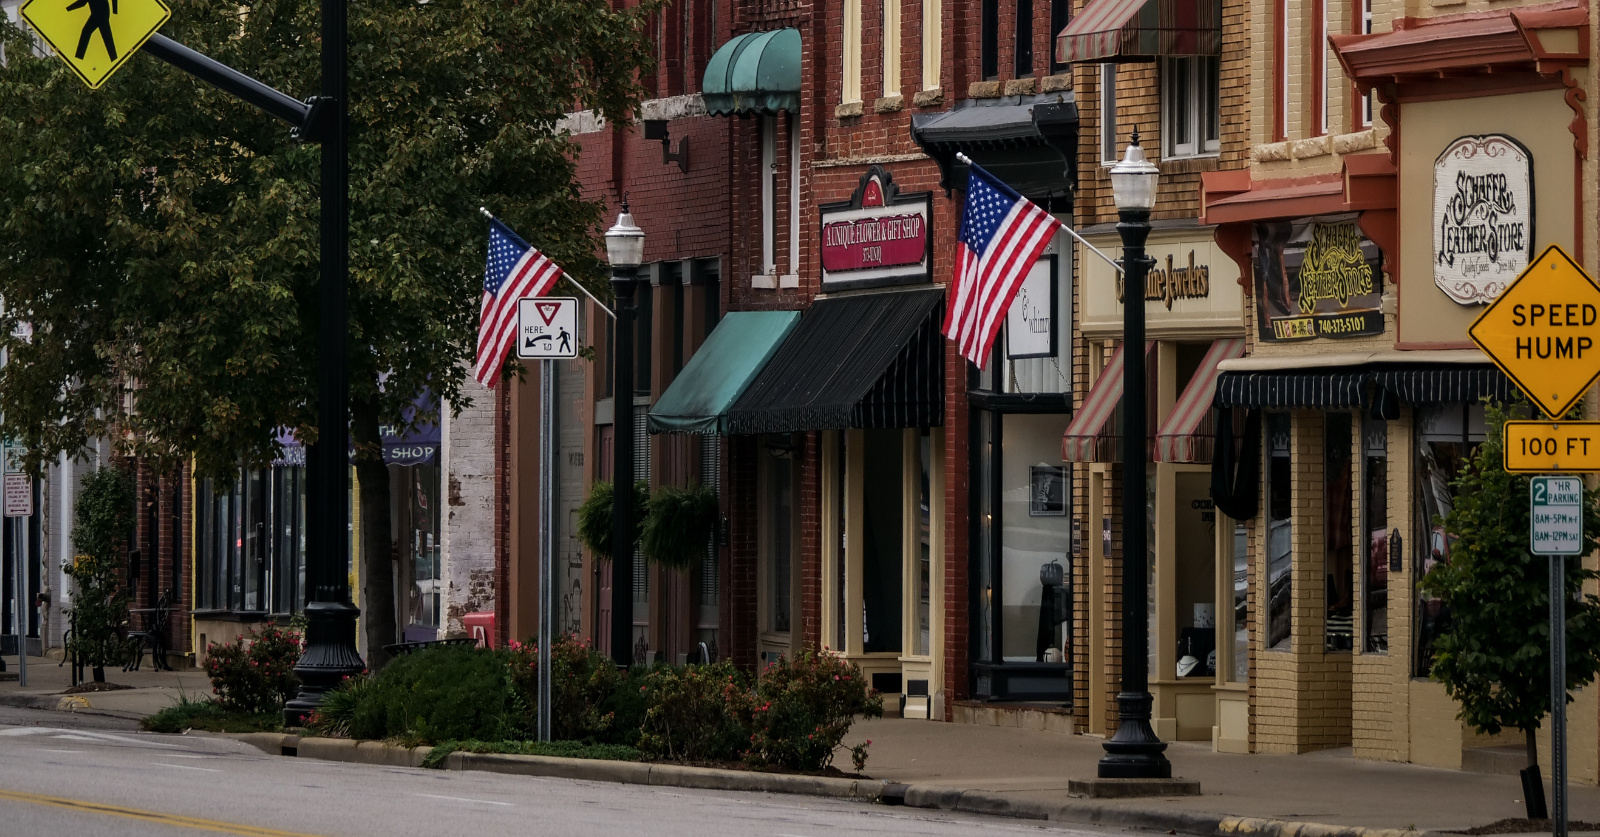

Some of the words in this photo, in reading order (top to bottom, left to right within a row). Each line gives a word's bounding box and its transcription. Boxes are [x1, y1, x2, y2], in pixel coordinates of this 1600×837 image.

[1453, 170, 1516, 226] SCHAFER
[826, 226, 832, 247] A
[831, 223, 856, 249] UNIQUE
[856, 221, 881, 244] FLOWER
[881, 222, 887, 241] &
[887, 219, 902, 241] GIFT
[902, 217, 920, 239] SHOP
[1438, 213, 1488, 268] LEATHER
[1488, 211, 1524, 263] STORE
[1309, 221, 1360, 272] SCHAFER
[1164, 249, 1208, 311] Jewelers
[1298, 262, 1338, 314] LEATHER
[1337, 262, 1373, 308] STORE
[1318, 316, 1365, 334] 740-373-5101
[1512, 303, 1597, 327] SPEED
[524, 325, 544, 334] HERE
[1516, 336, 1593, 360] HUMP
[391, 446, 434, 459] SHOP
[1520, 437, 1558, 456] 100
[1566, 437, 1591, 456] FT
[1534, 482, 1546, 502] 2
[1557, 481, 1571, 491] HR
[1548, 493, 1579, 504] PARKING
[1535, 513, 1567, 524] 8AM-5PM
[1534, 531, 1568, 541] 8AM-12PM
[1569, 533, 1579, 541] SAT
